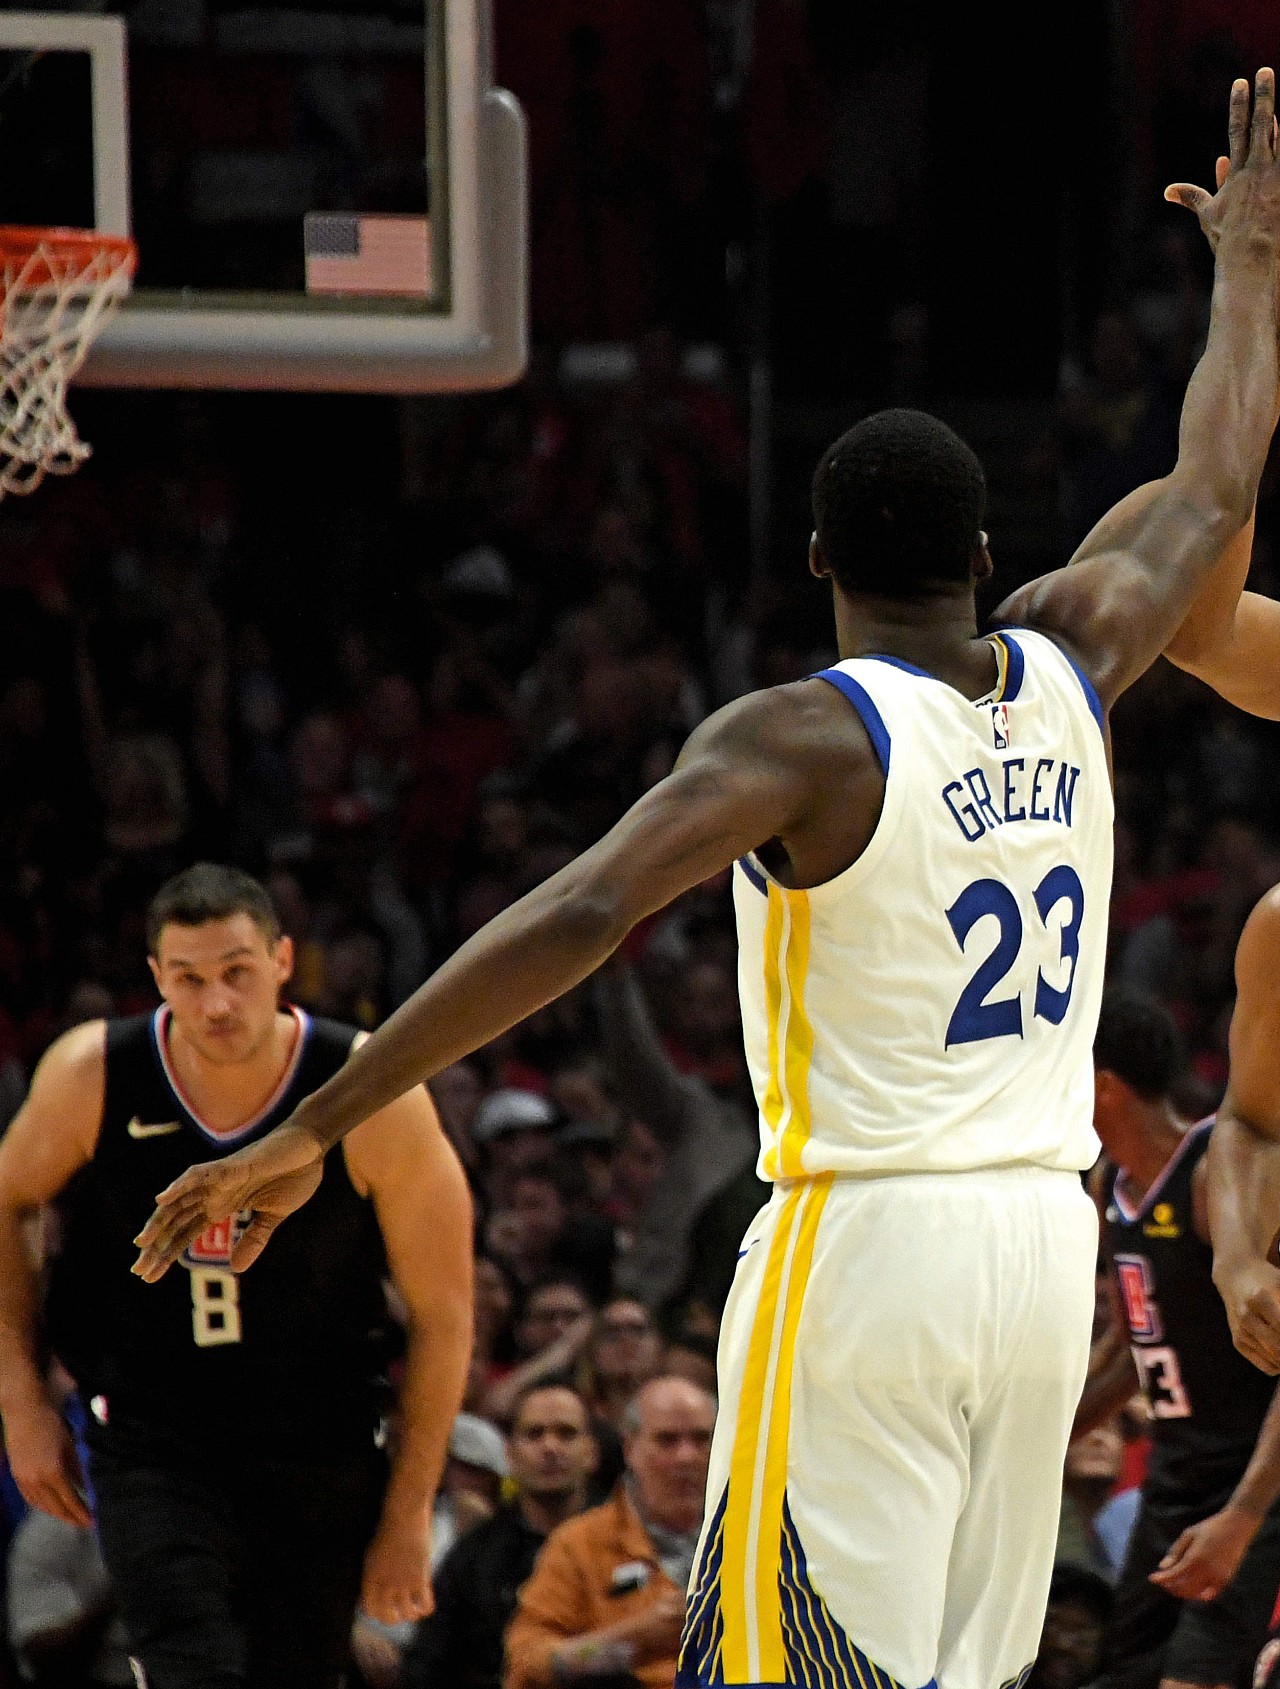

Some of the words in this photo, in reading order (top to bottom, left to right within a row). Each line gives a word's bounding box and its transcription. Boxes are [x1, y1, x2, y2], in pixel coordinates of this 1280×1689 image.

[942, 758, 1080, 842] GREEN
[945, 865, 1084, 1051] 23
[190, 1267, 243, 1348] 8
[1130, 1345, 1193, 1420] 3
